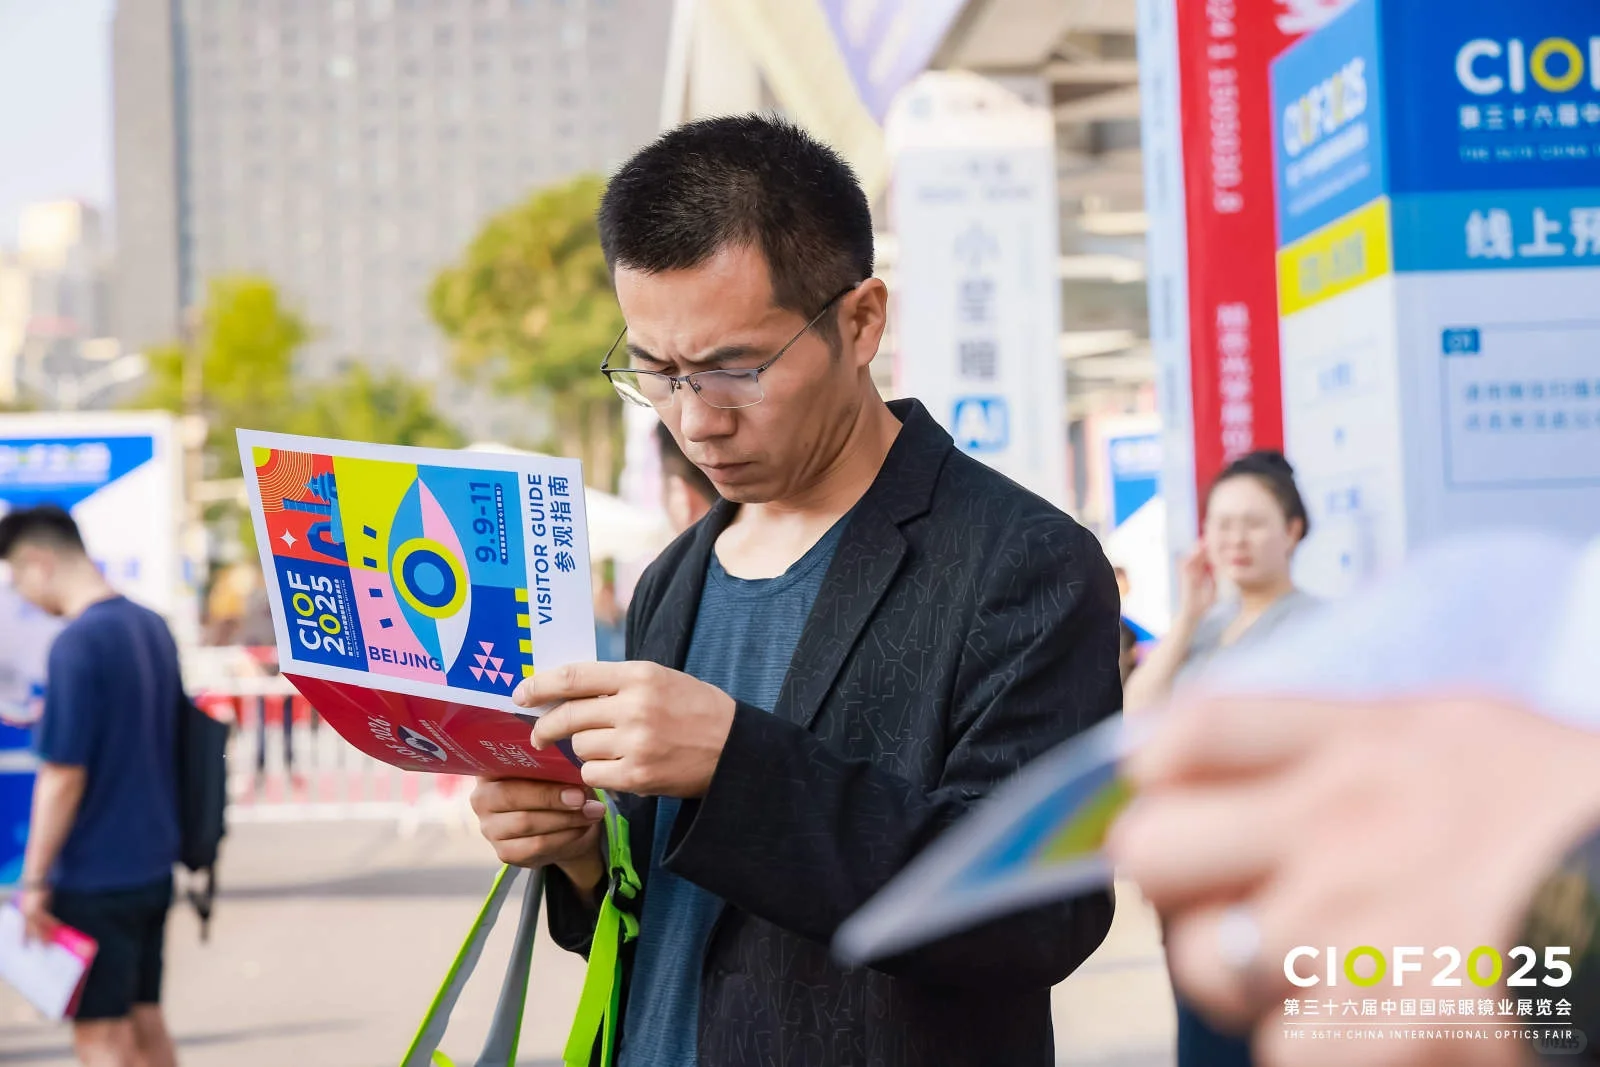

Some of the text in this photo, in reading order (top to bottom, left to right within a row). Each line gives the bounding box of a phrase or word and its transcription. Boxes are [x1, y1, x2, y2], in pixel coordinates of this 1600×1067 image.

[469, 481, 497, 563] 9.9-11
[528, 473, 553, 625] VISITOR GUIDE
[548, 475, 576, 573] 参观指南
[287, 570, 322, 650] CIOF
[310, 575, 346, 656] 2025
[368, 645, 442, 671] BEIJING
